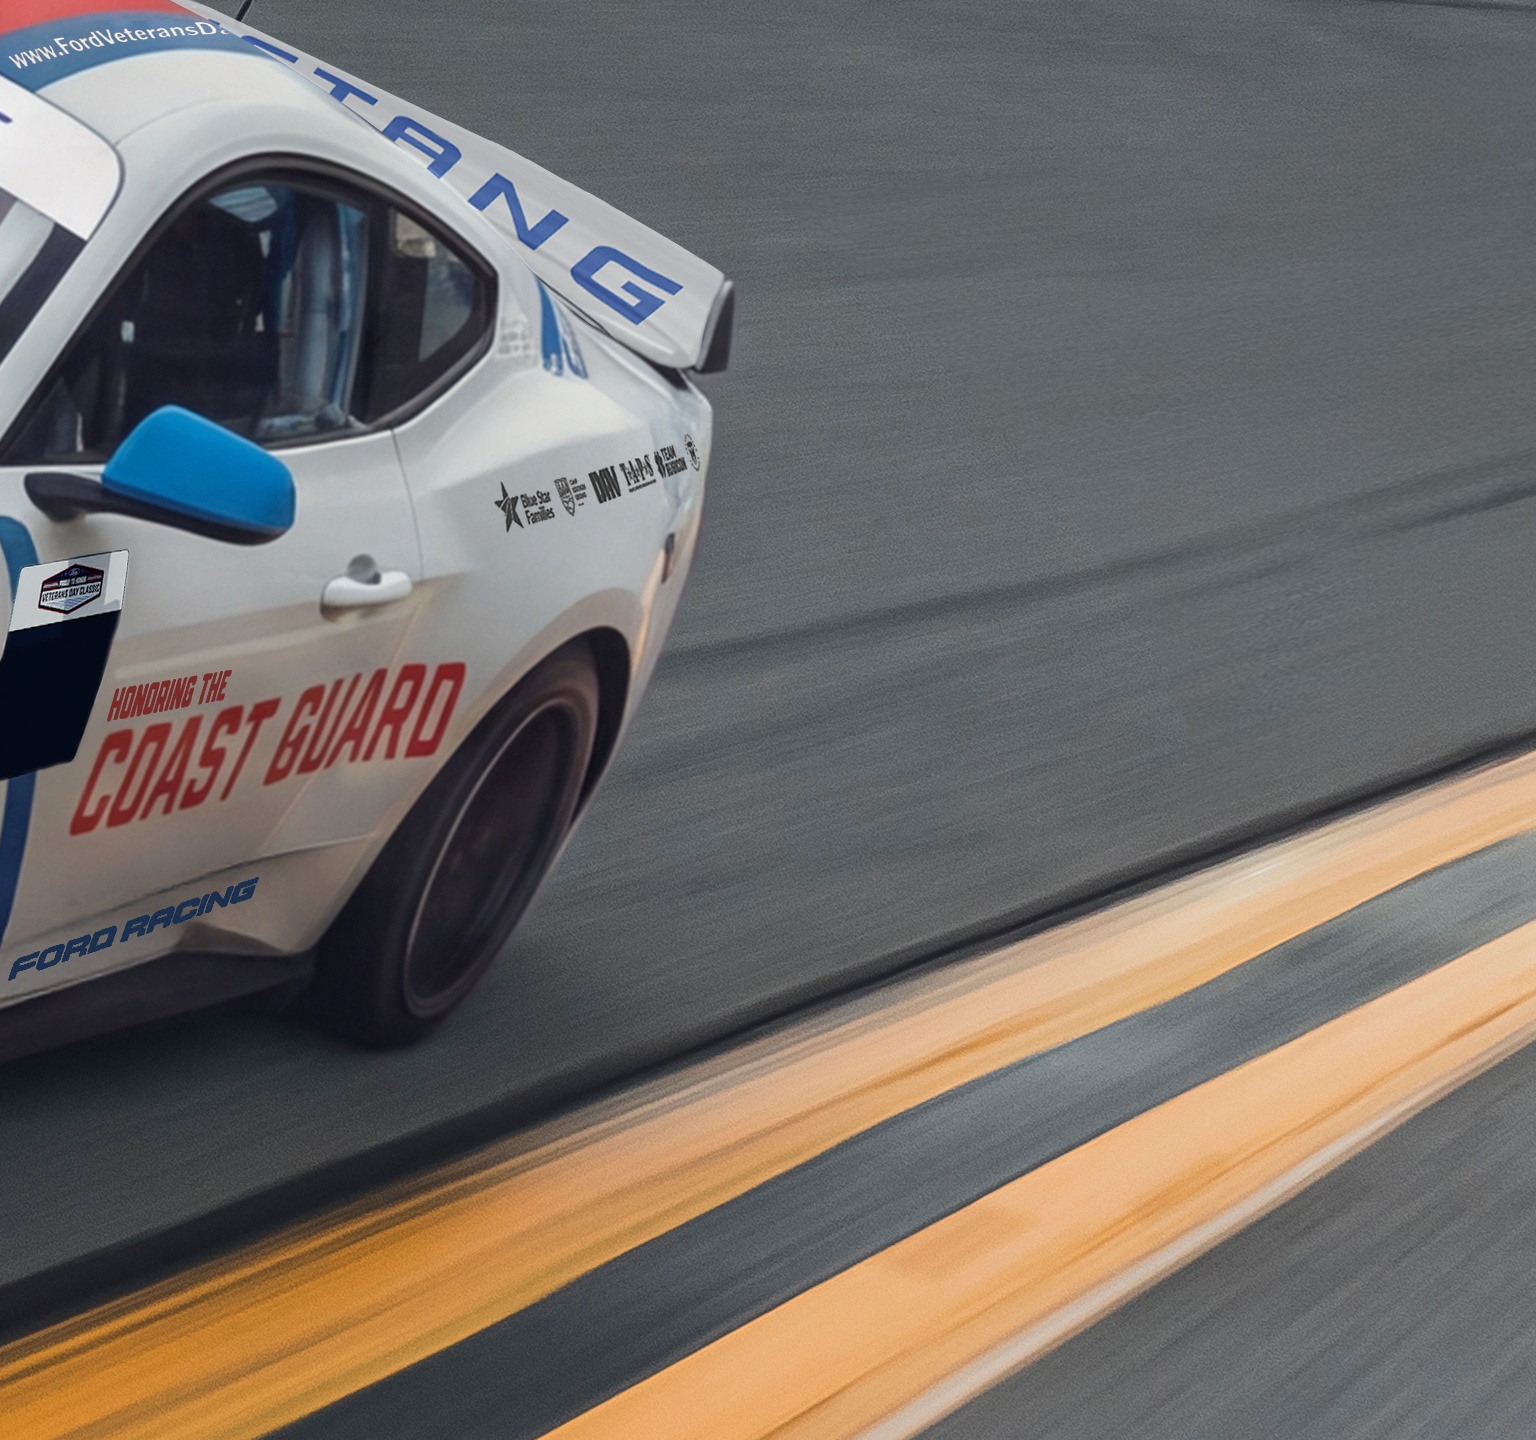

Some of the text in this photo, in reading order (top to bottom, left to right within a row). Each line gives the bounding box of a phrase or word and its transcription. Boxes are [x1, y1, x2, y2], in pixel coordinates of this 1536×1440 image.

[660, 444, 677, 461] TEAM
[520, 493, 538, 509] Blue
[536, 490, 552, 505] Star
[525, 506, 555, 525] Families
[42, 583, 101, 602] VETERANS DAY CLASSIC
[107, 669, 232, 722] HONORING THE
[69, 661, 466, 837] COAST GUARD
[8, 876, 259, 982] FORD RACING
